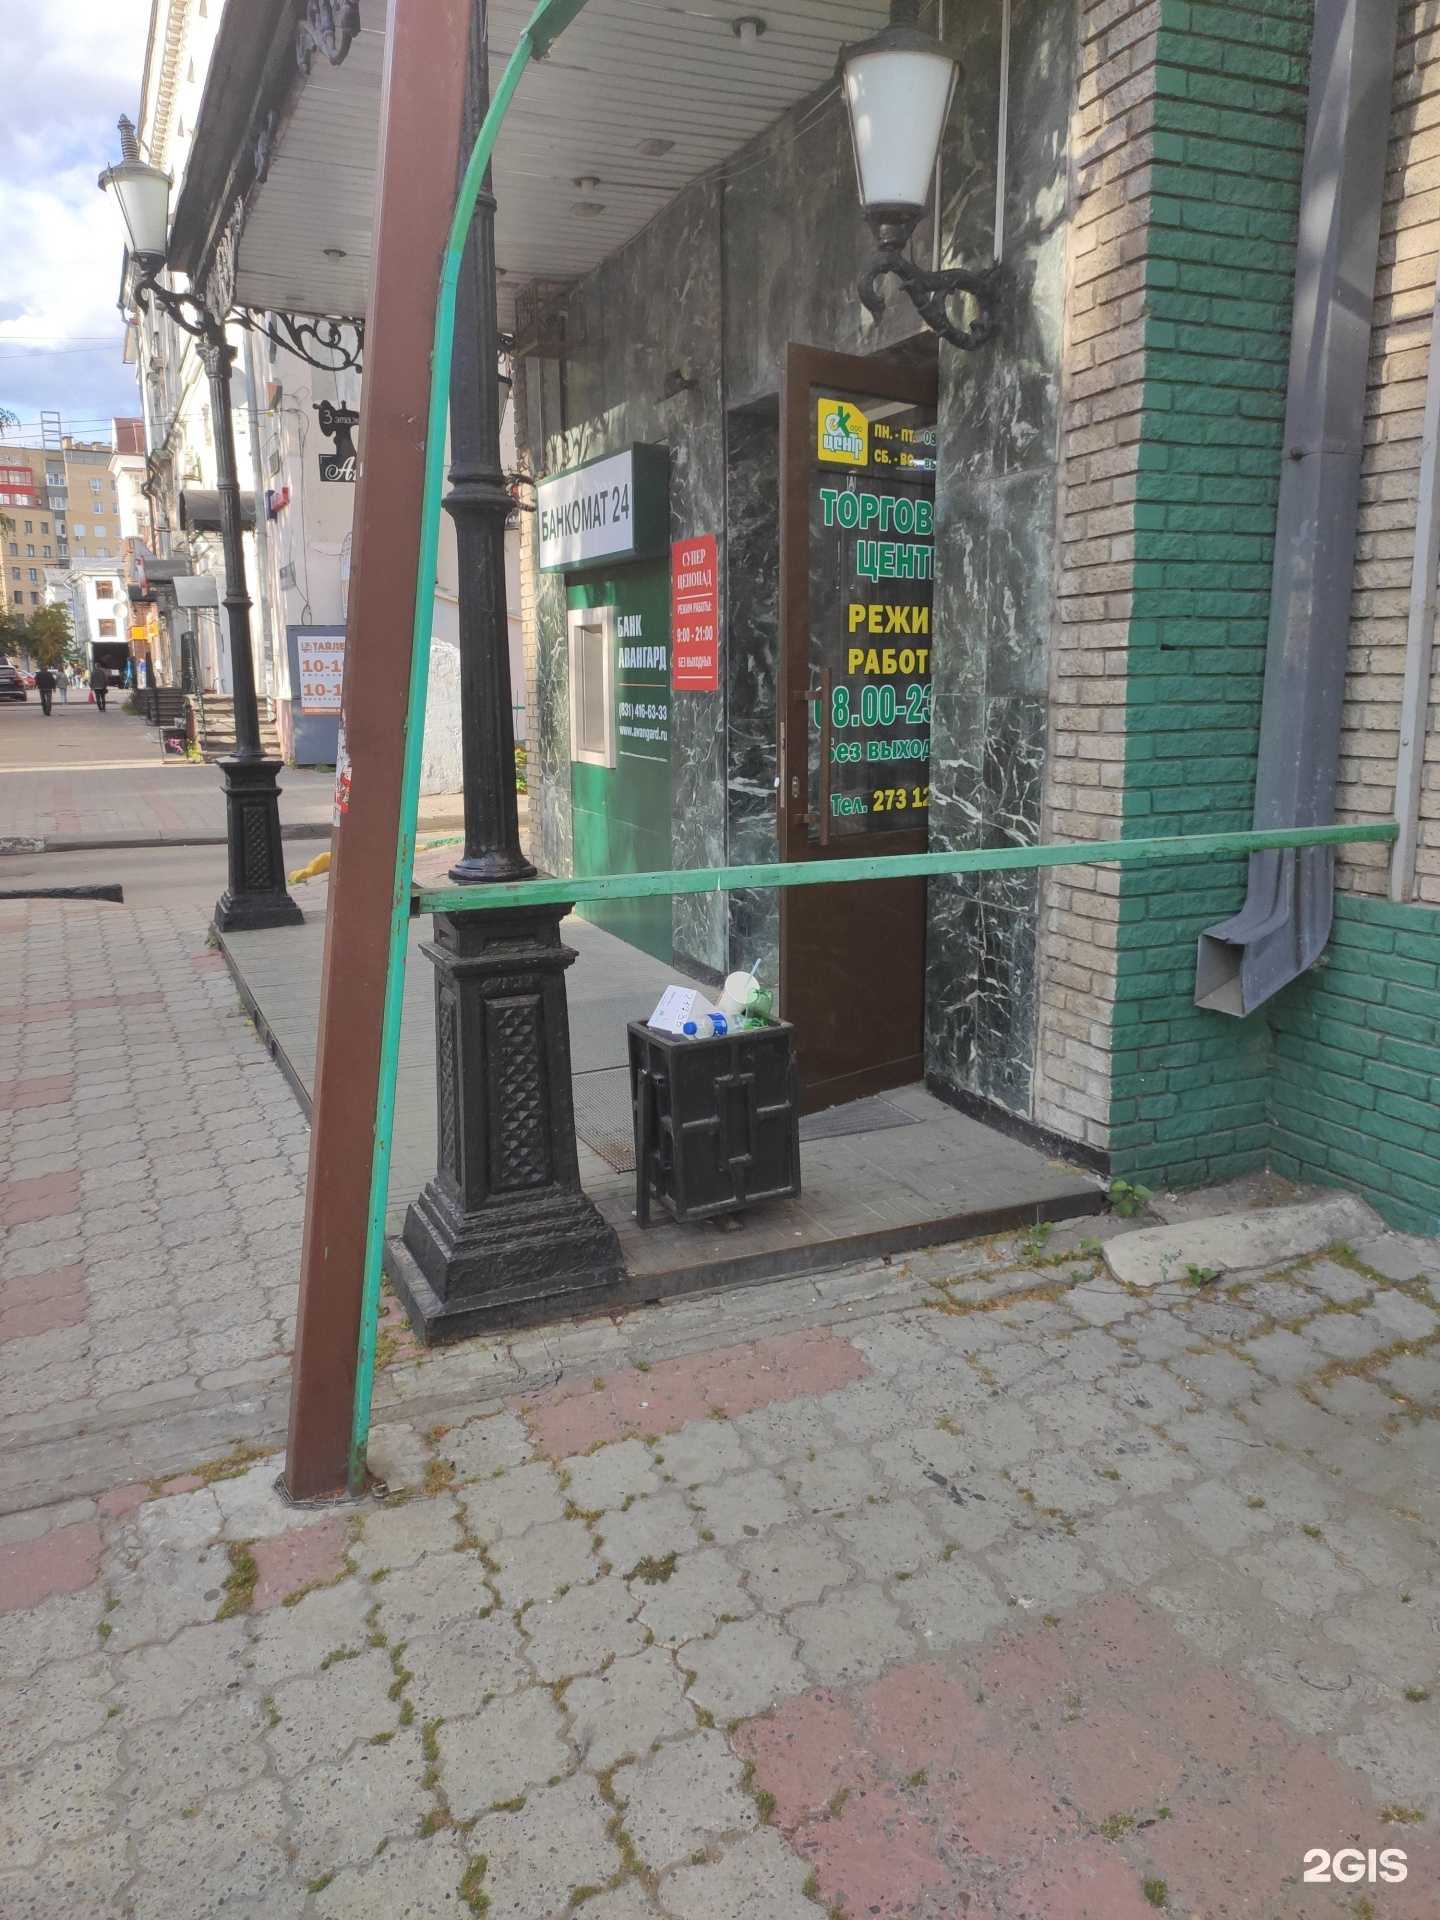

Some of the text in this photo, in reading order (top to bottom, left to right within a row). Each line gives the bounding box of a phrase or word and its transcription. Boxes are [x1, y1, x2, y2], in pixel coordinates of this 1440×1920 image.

[874, 449, 891, 464] СБ.
[541, 483, 630, 542] БАНКОМАТ 24
[820, 488, 935, 536] ТОРГОВ
[682, 549, 706, 567] СУПЕР
[677, 569, 713, 590] ЦЕНОПАД
[617, 614, 642, 638] БАНК
[848, 603, 929, 634] РЕЖИ
[677, 627, 690, 643] 9:00
[695, 625, 713, 641] 21:00
[303, 660, 342, 672] 10-1
[618, 646, 667, 671] АВАНГАРД
[848, 648, 929, 675] РАБОТ
[619, 702, 667, 721] (831) 416-63-33
[619, 725, 668, 741] www.avangard.ru
[831, 792, 868, 816] Тел.
[872, 787, 906, 812] 273
